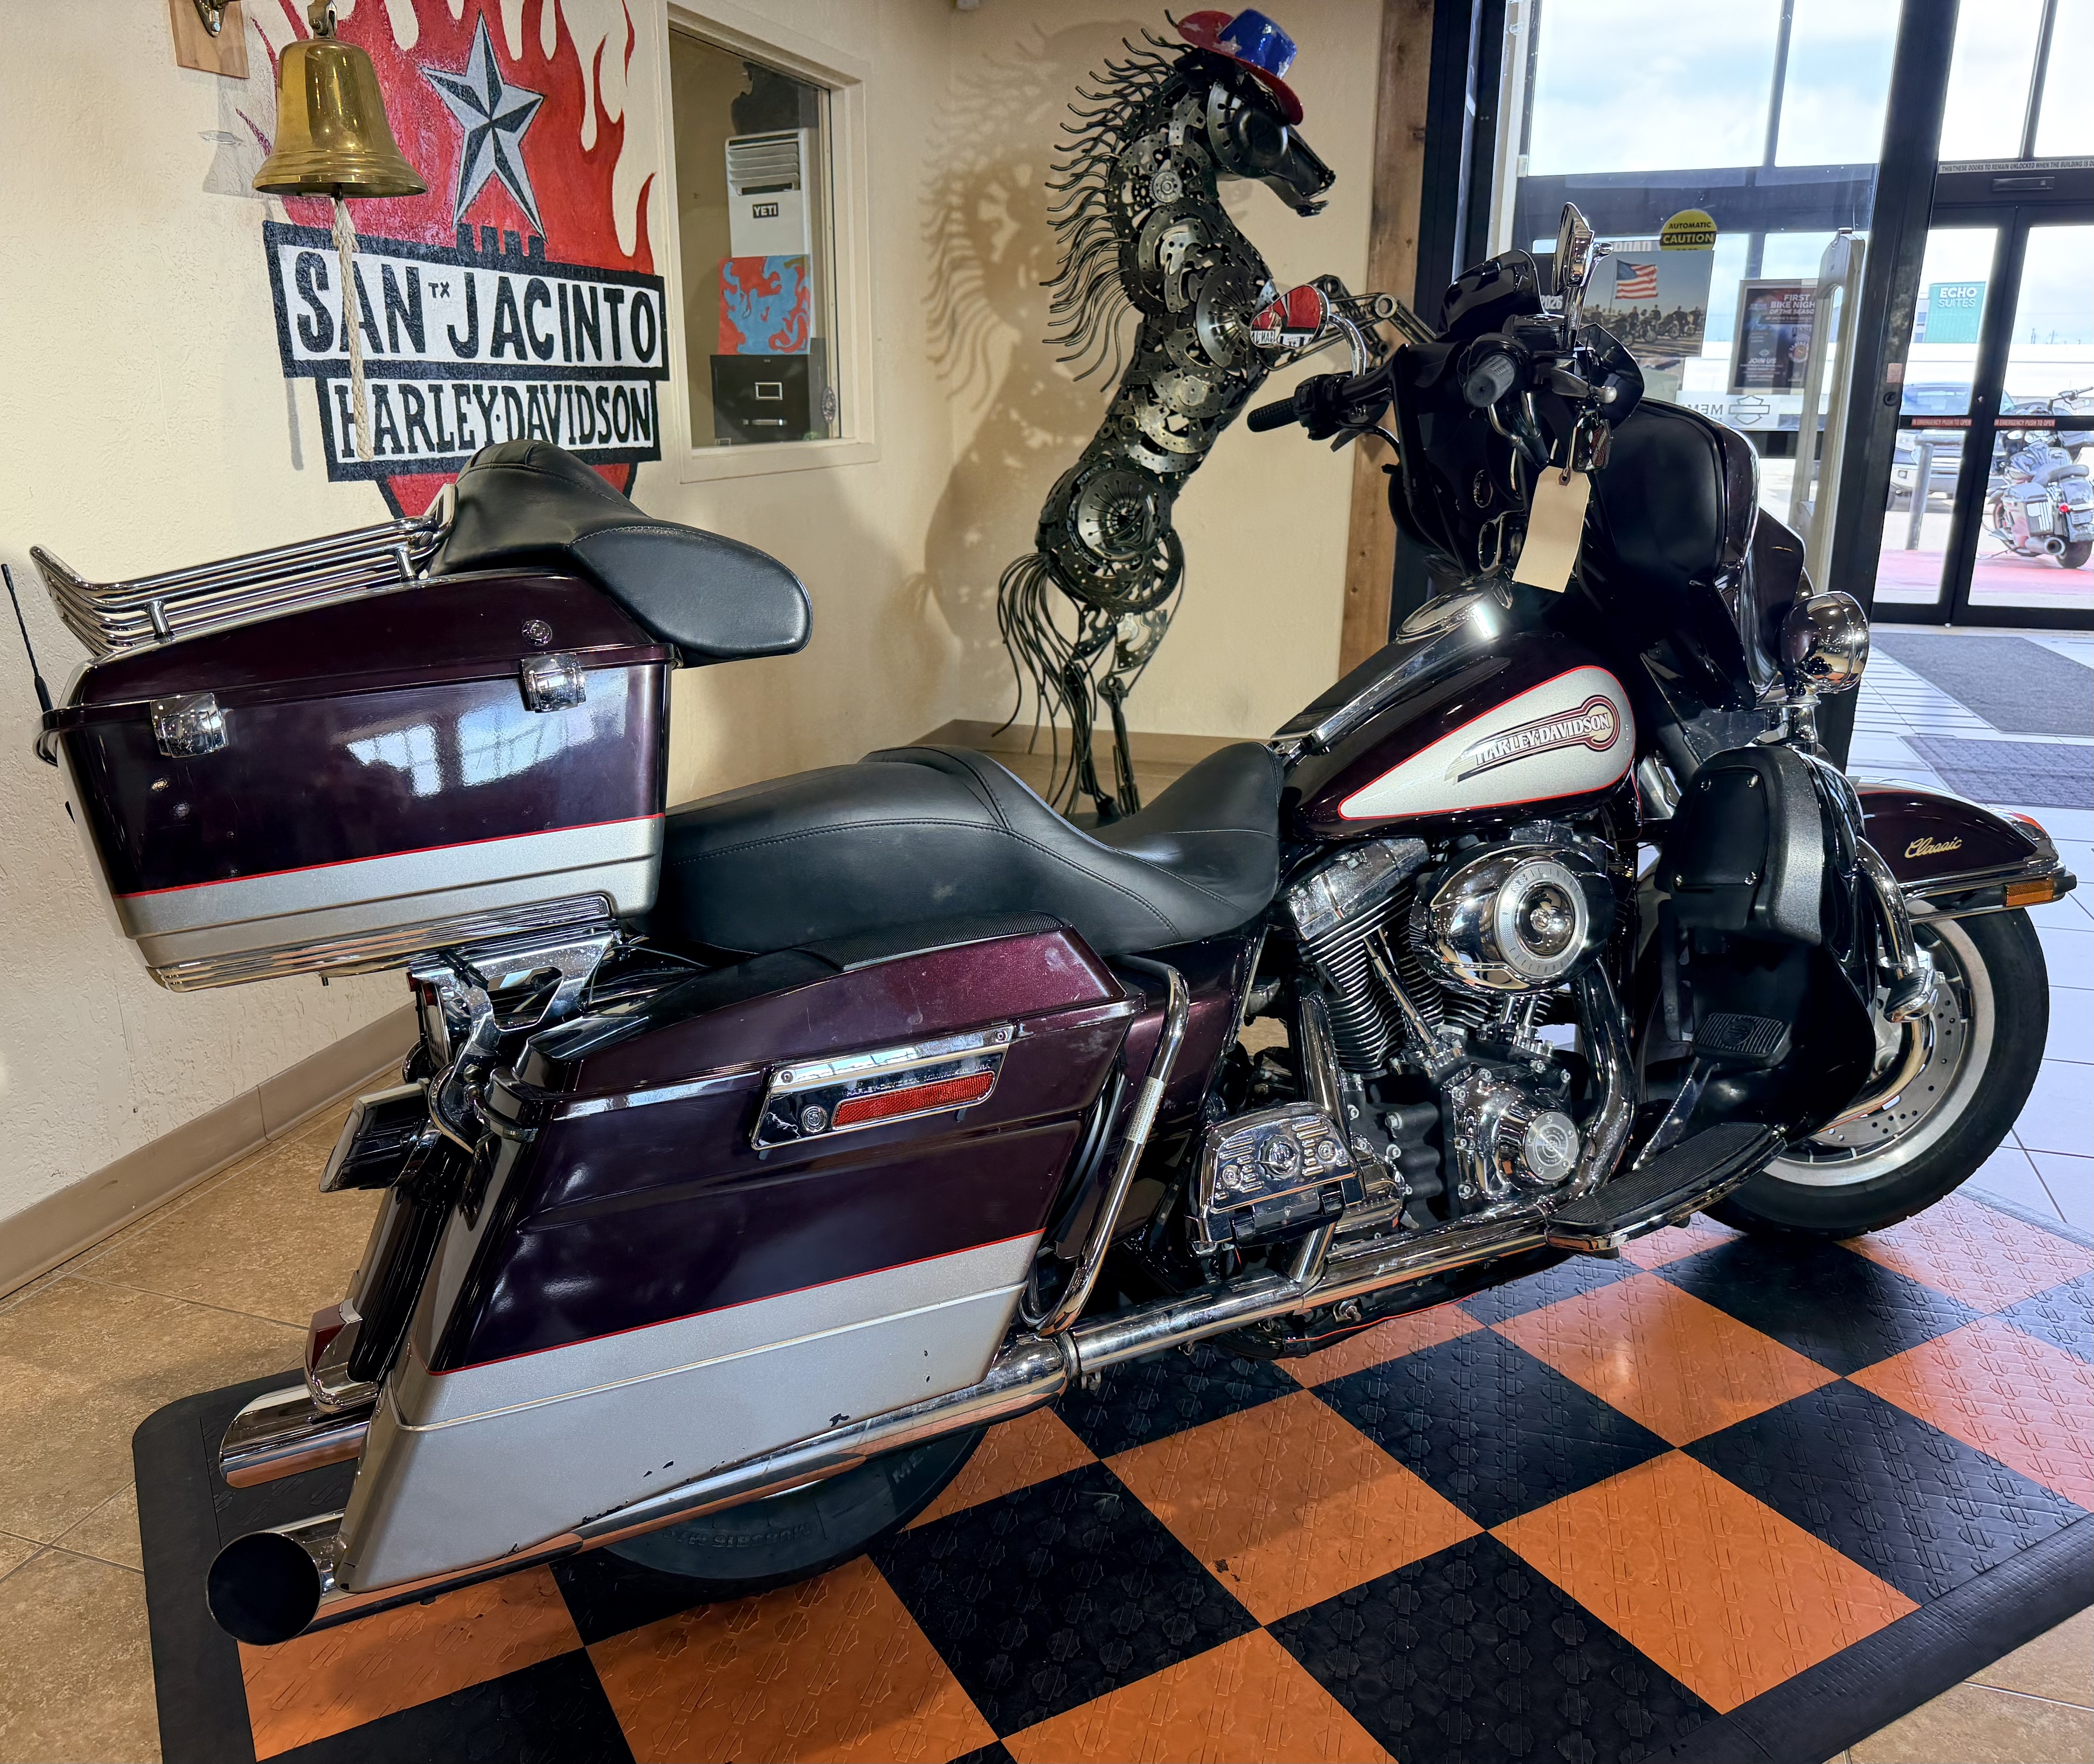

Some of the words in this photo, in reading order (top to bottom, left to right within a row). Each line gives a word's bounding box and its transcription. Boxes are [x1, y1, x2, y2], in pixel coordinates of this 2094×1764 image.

[753, 205, 777, 216] YETI
[1663, 234, 1714, 244] CAUTION
[1940, 287, 1977, 298] ECHO
[295, 251, 426, 354] SAN
[428, 281, 450, 299] TX
[447, 271, 656, 363] JACINTO
[1938, 298, 1976, 308] SUITES
[1904, 836, 1962, 858] Classic
